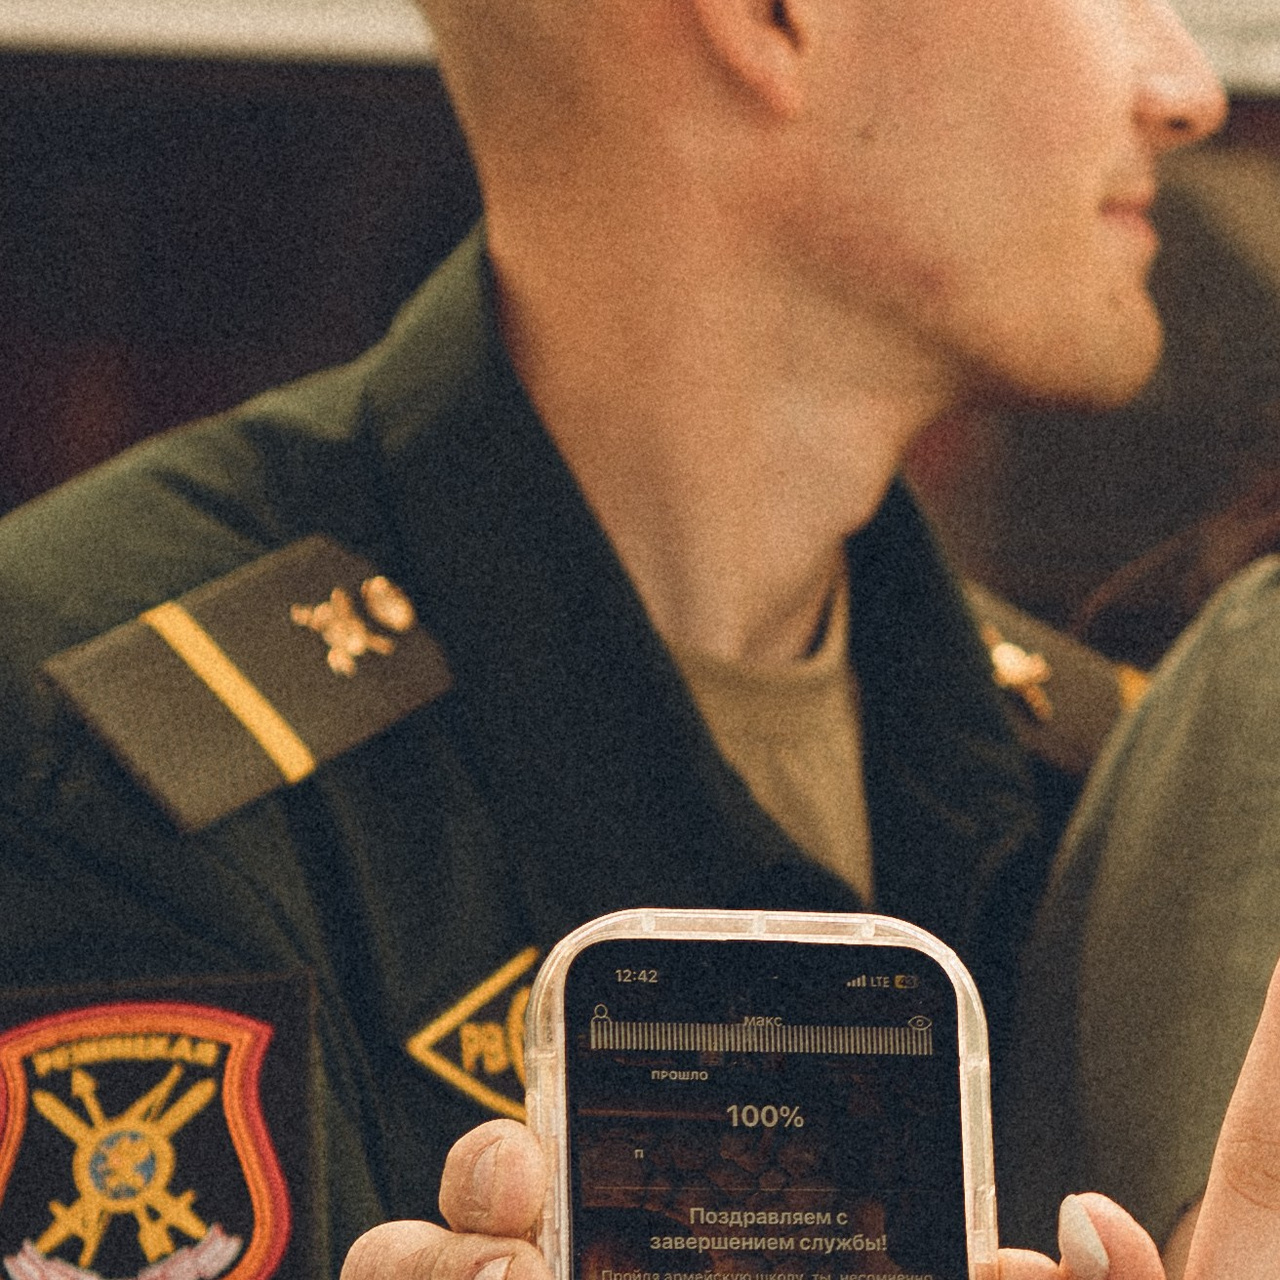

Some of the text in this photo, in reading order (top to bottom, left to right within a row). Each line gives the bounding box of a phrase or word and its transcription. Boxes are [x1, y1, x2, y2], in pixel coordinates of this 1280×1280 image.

[615, 969, 658, 983] 12:42
[870, 976, 890, 987] LTE
[742, 1015, 783, 1027] макс
[651, 1070, 709, 1081] прошло
[726, 1105, 804, 1128] 100%
[689, 1208, 848, 1227] Поздравляем с
[649, 1234, 888, 1254] завершением службы!
